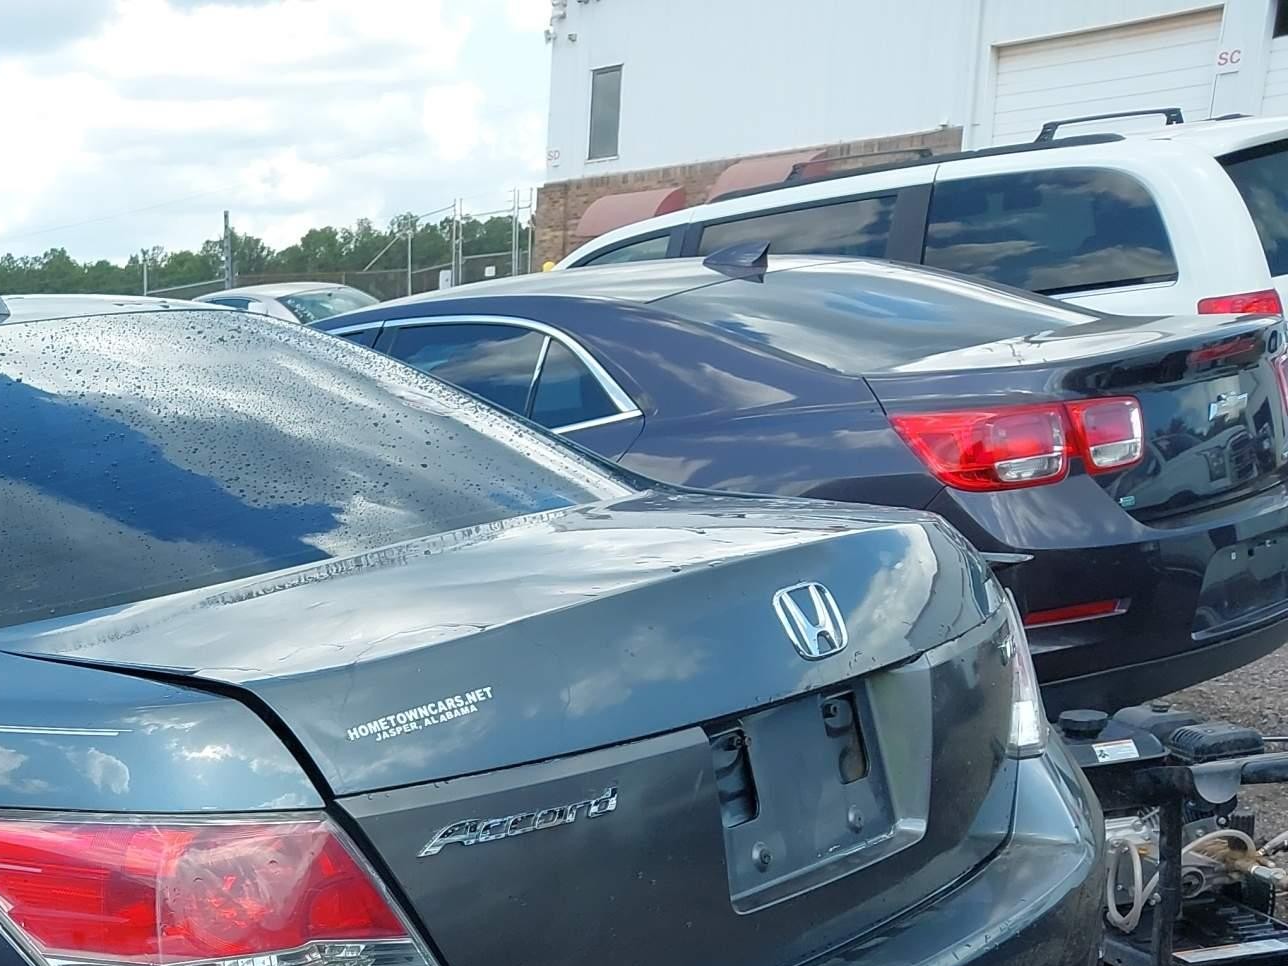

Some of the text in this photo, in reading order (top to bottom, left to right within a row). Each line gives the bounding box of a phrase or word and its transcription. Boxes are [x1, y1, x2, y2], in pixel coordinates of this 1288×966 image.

[1217, 49, 1241, 66] SC
[347, 686, 494, 741] HOMETOWNCARS.NET
[375, 704, 478, 742] JASPER, ALABAMA
[416, 786, 619, 858] Accord
